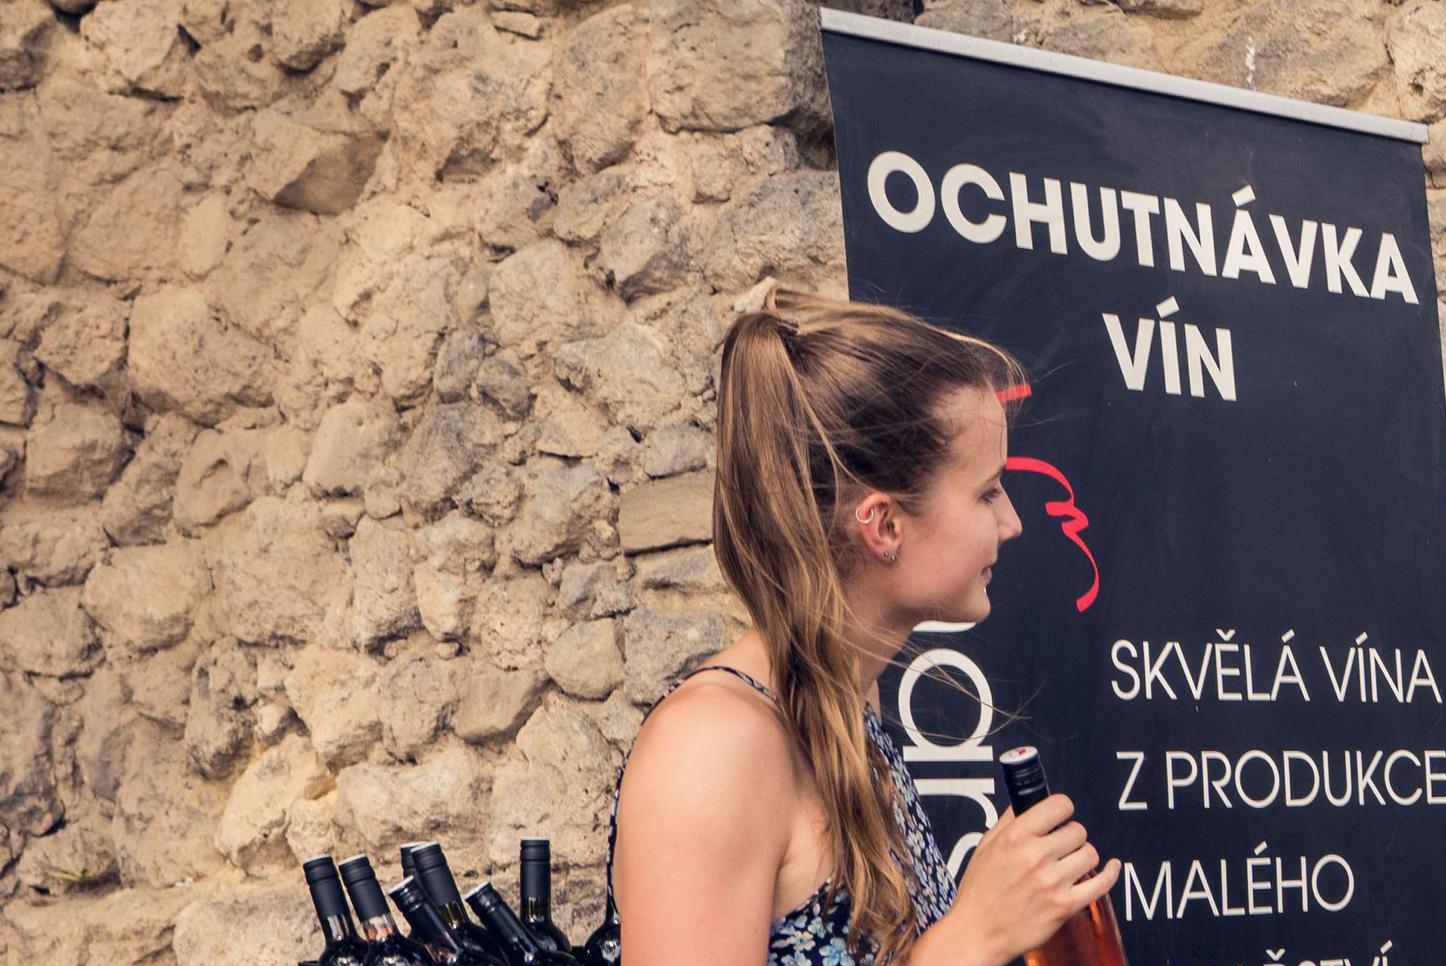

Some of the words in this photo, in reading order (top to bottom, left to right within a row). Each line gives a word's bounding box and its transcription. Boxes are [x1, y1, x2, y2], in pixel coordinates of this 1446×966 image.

[867, 151, 1420, 304] OCHUTNÁVKA
[1102, 296, 1237, 402] VÍN
[1111, 629, 1311, 702] SKVĚLÁ
[1319, 631, 1443, 704] VÍNA
[1116, 751, 1148, 811] Z
[1124, 841, 1355, 922] MALÉHO
